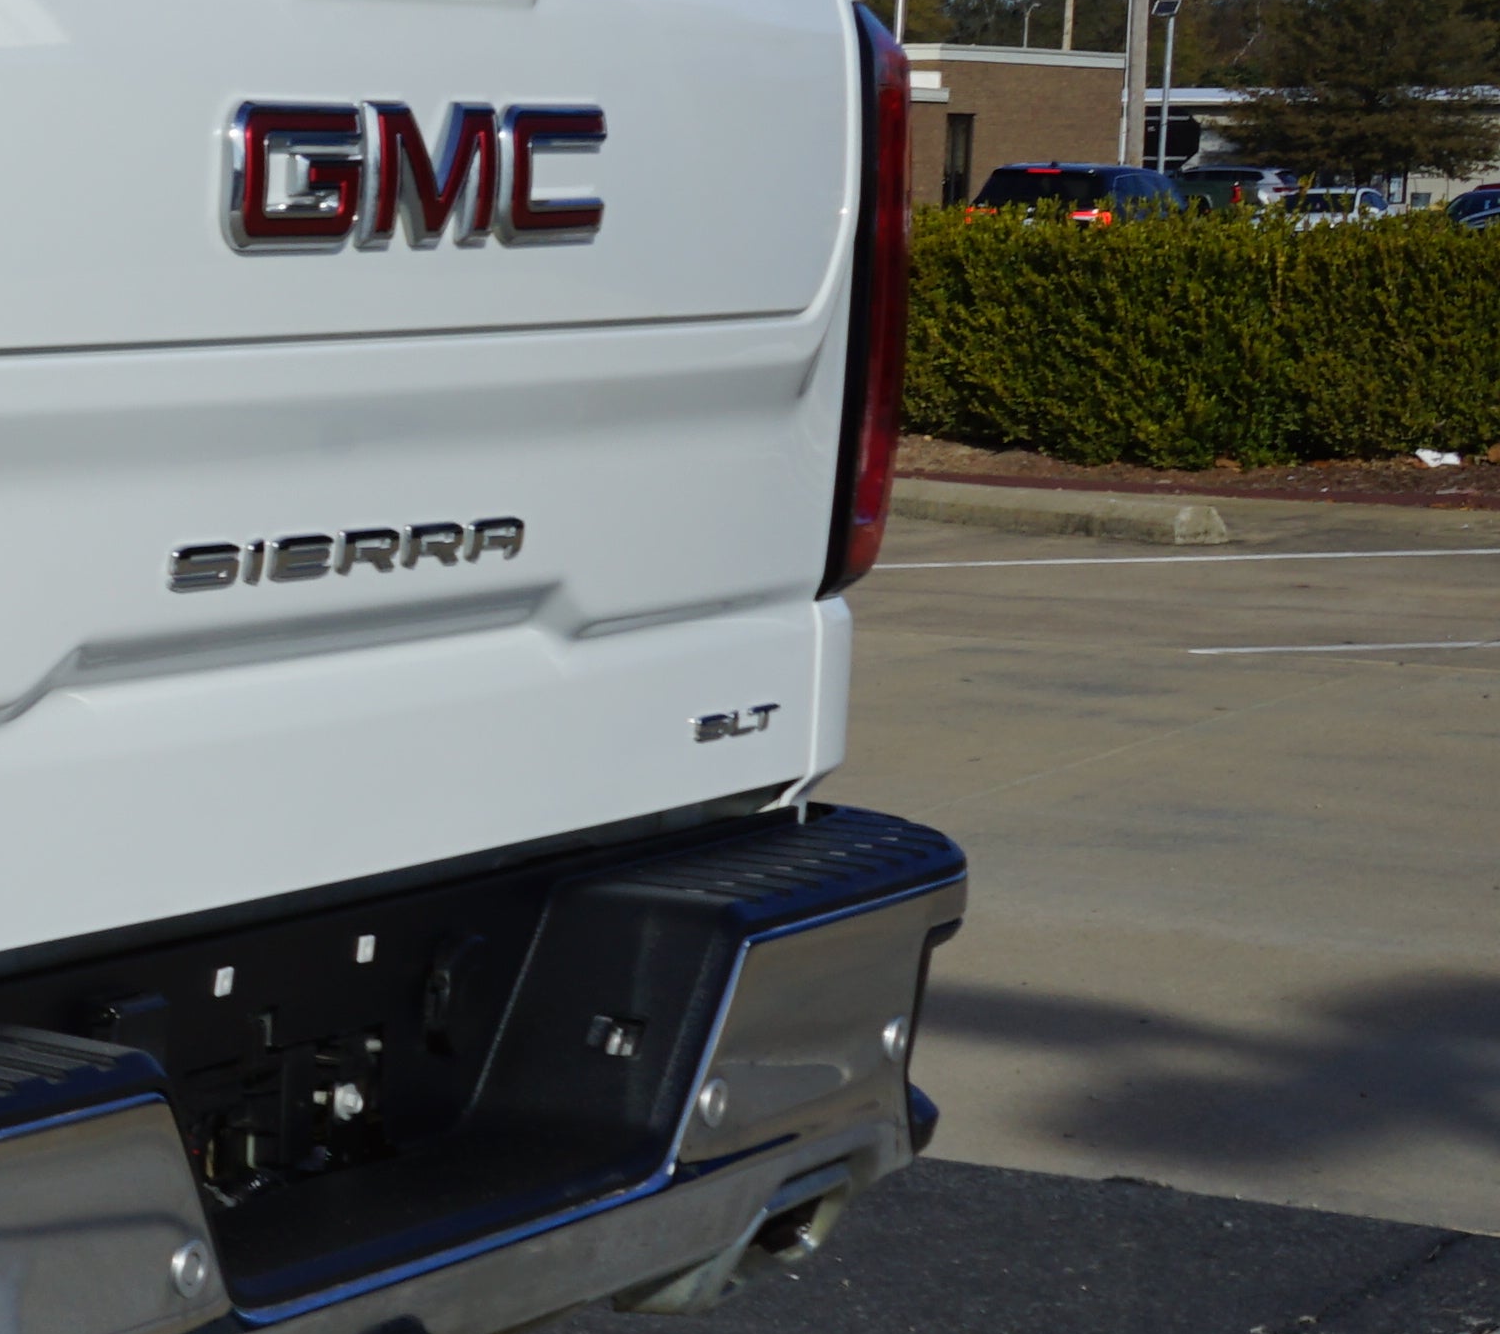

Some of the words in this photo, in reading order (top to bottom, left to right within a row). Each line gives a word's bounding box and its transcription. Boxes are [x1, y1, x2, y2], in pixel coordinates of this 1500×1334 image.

[222, 99, 608, 255] GMC
[166, 515, 526, 594] SIERRA
[691, 702, 782, 744] SLT
